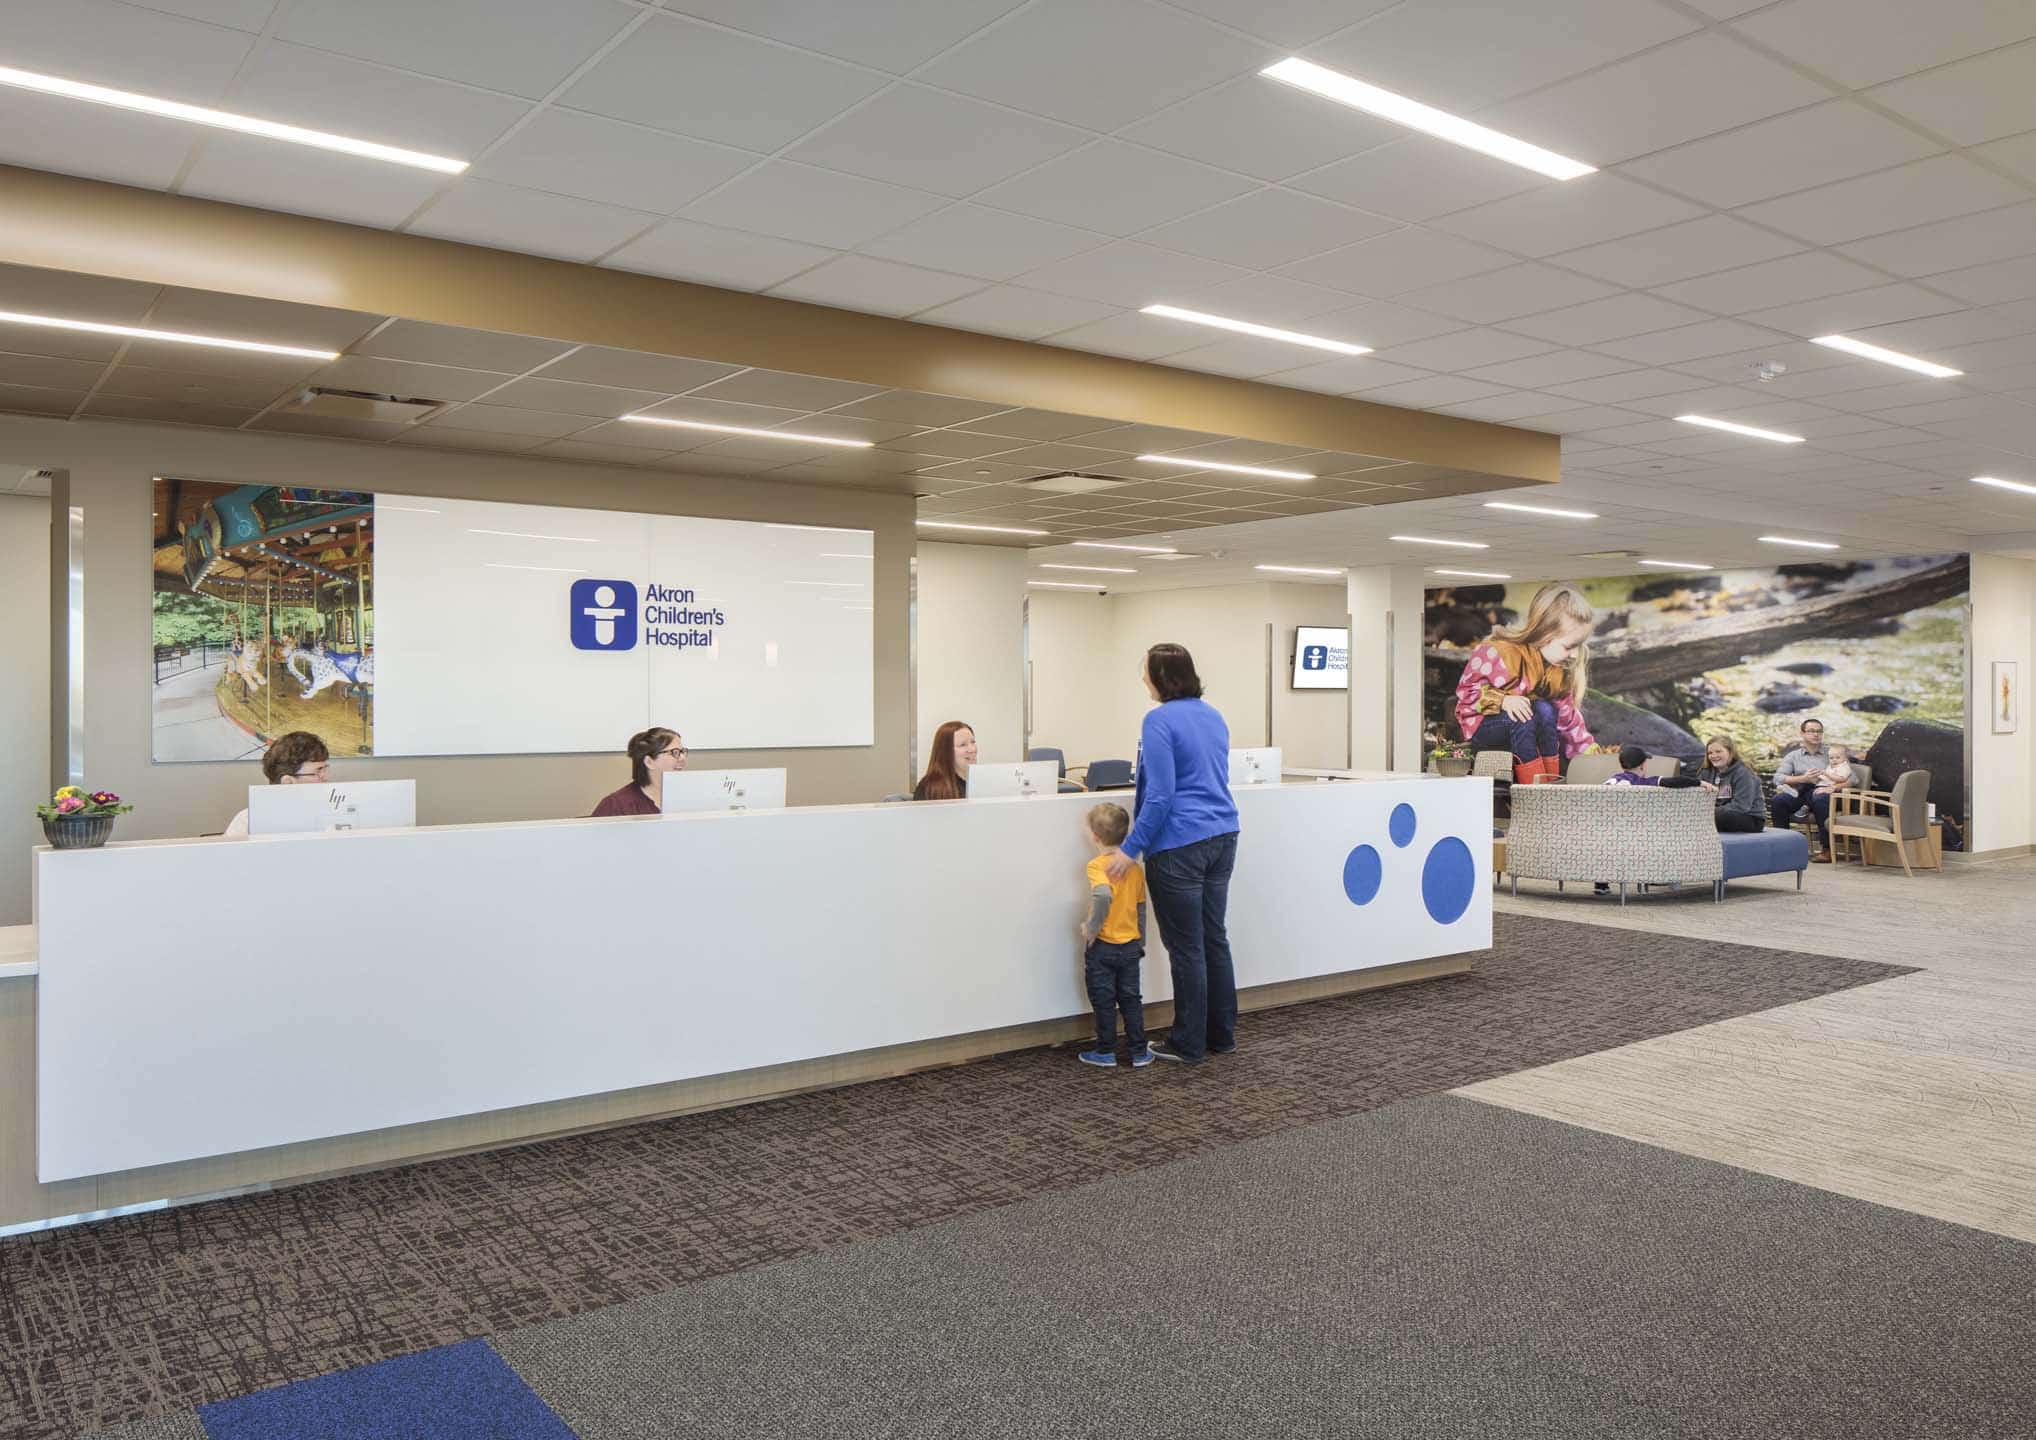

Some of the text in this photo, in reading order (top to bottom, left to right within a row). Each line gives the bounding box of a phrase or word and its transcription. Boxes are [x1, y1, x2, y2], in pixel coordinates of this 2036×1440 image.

[645, 584, 694, 603] Akron
[645, 605, 725, 626] Children's
[645, 627, 713, 650] Hospital
